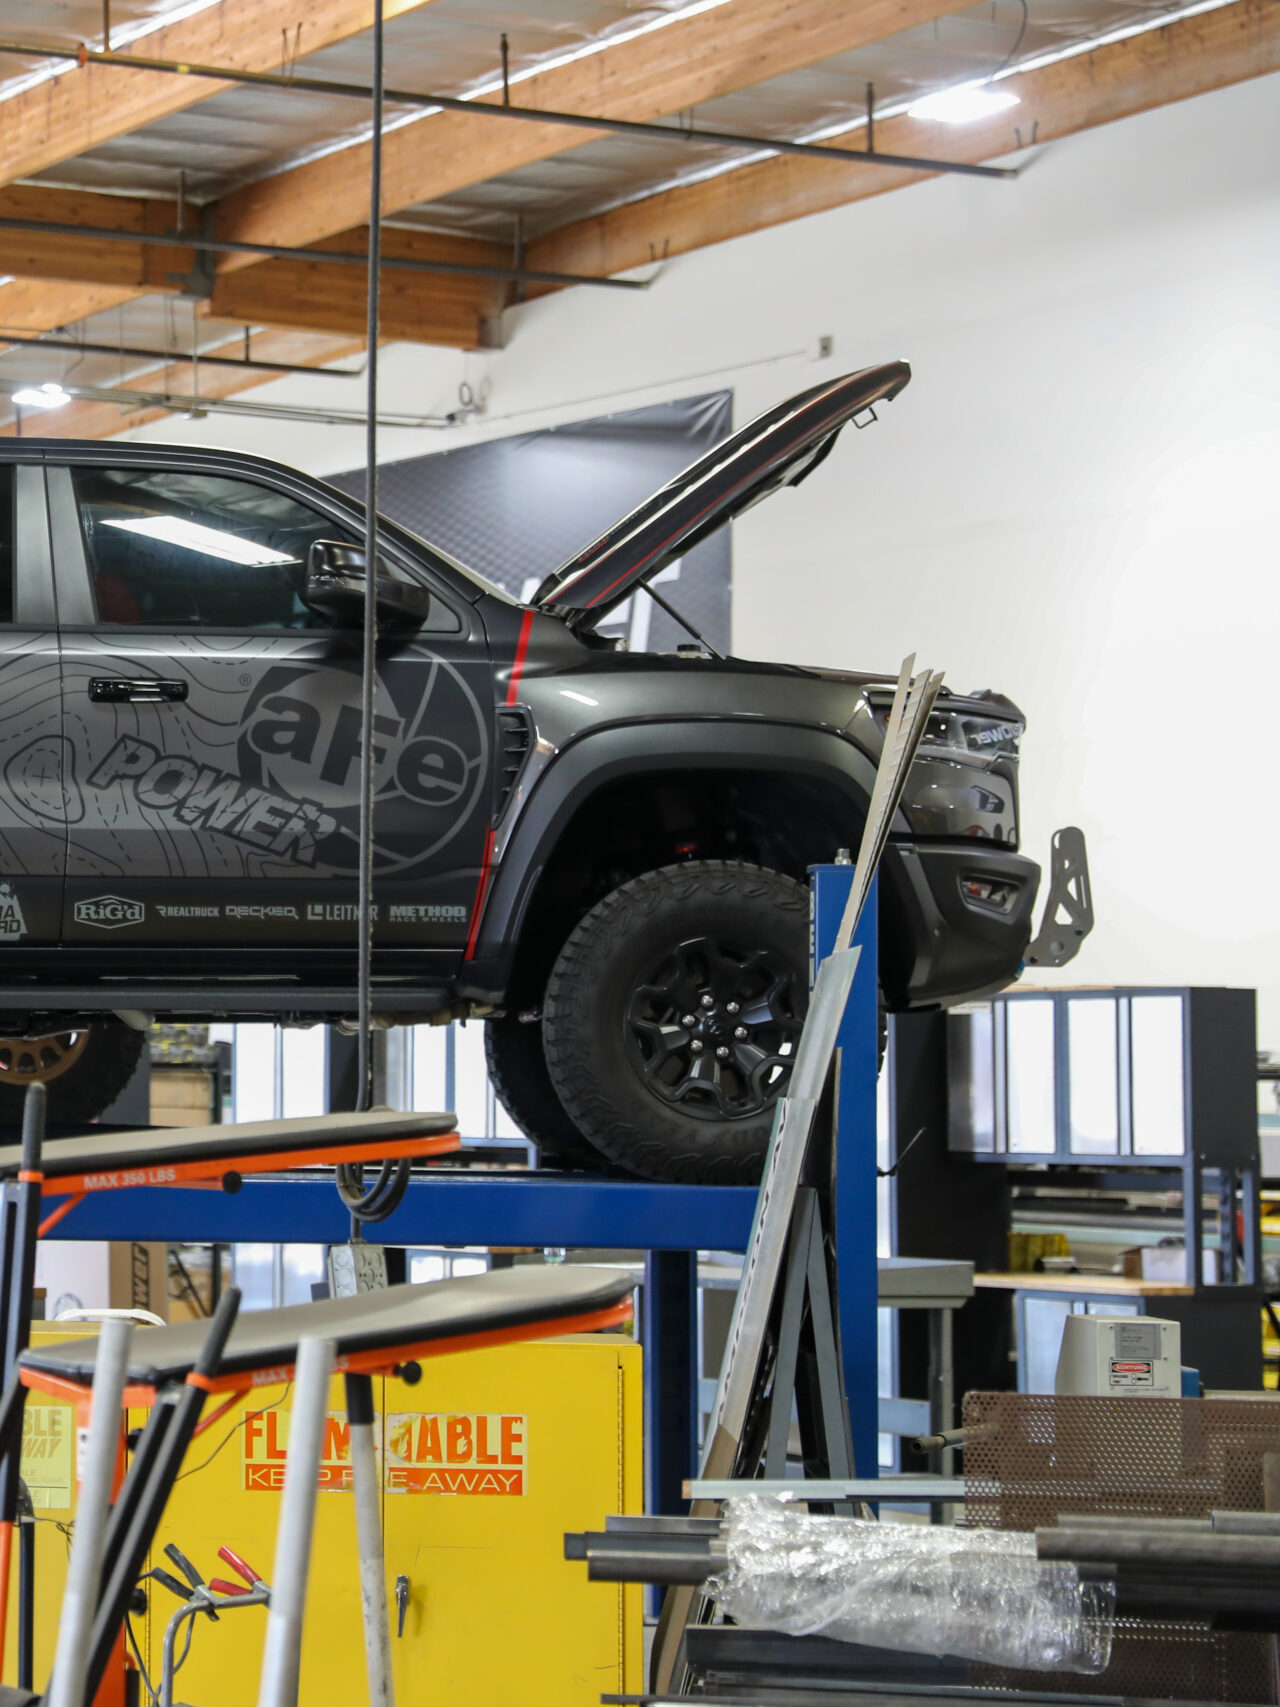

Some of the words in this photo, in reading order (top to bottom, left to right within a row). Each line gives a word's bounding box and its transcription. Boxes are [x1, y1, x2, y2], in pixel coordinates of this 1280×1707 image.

[248, 693, 470, 807] aFe
[87, 733, 338, 868] POWER
[167, 906, 220, 918] REALTRUCK
[225, 905, 300, 920] DECKED
[325, 904, 379, 921] LEITNR
[389, 905, 467, 917] METHOD
[83, 1174, 119, 1190] MAX
[121, 1172, 146, 1187] 350
[148, 1168, 177, 1184] LBS
[251, 1367, 291, 1389] MAX
[248, 1468, 332, 1487] KEP
[422, 1473, 518, 1492] AWAY
